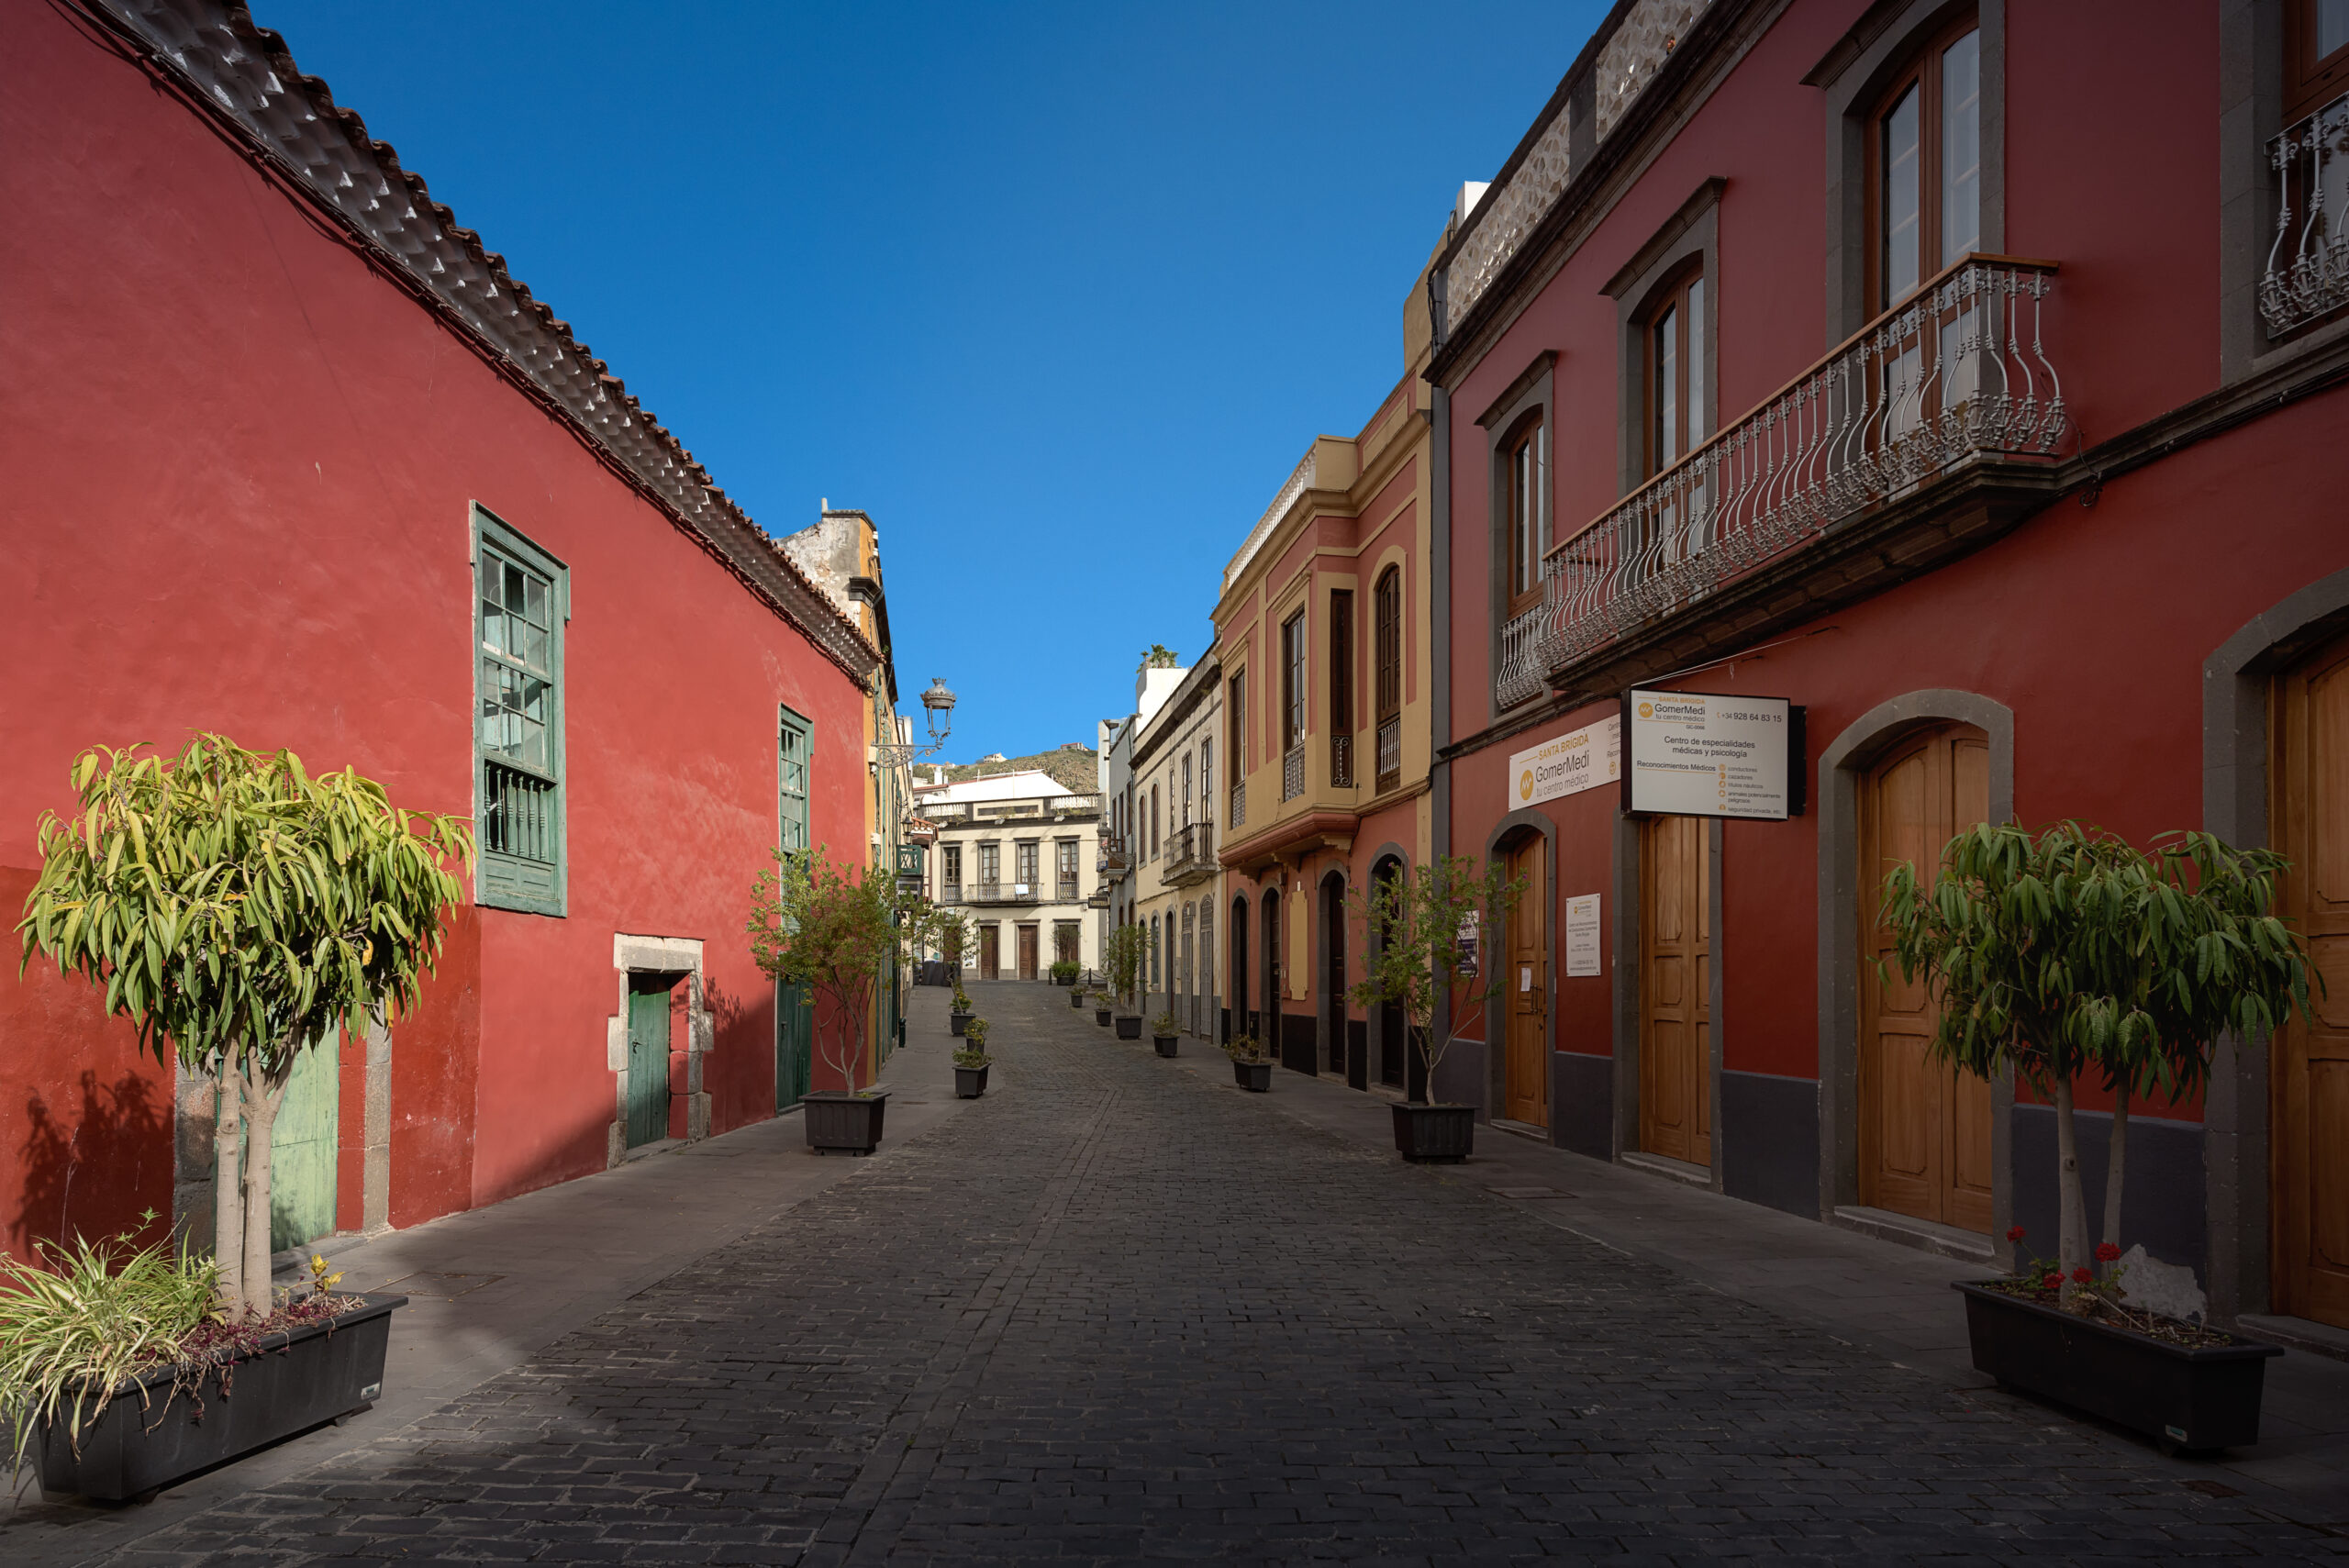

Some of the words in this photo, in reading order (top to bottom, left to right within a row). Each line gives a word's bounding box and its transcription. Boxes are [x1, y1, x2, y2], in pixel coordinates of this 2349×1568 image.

[1654, 704, 1705, 715] GomerMedi
[1761, 714, 1771, 722] 83
[1773, 715, 1782, 723] 15
[1538, 744, 1560, 761] SANTA
[1561, 733, 1589, 752] BRÍGIDA
[1664, 736, 1688, 744] Centro
[1702, 739, 1755, 749] especialidades
[1672, 746, 1703, 755] médicas
[1711, 748, 1748, 759] psicología
[1536, 750, 1590, 783] GomerMedi
[1636, 760, 1689, 770] Reconocimientos
[1690, 763, 1717, 772] Médicos
[1536, 786, 1542, 797] tu
[1543, 779, 1564, 795] centro
[1564, 773, 1589, 789] médico
